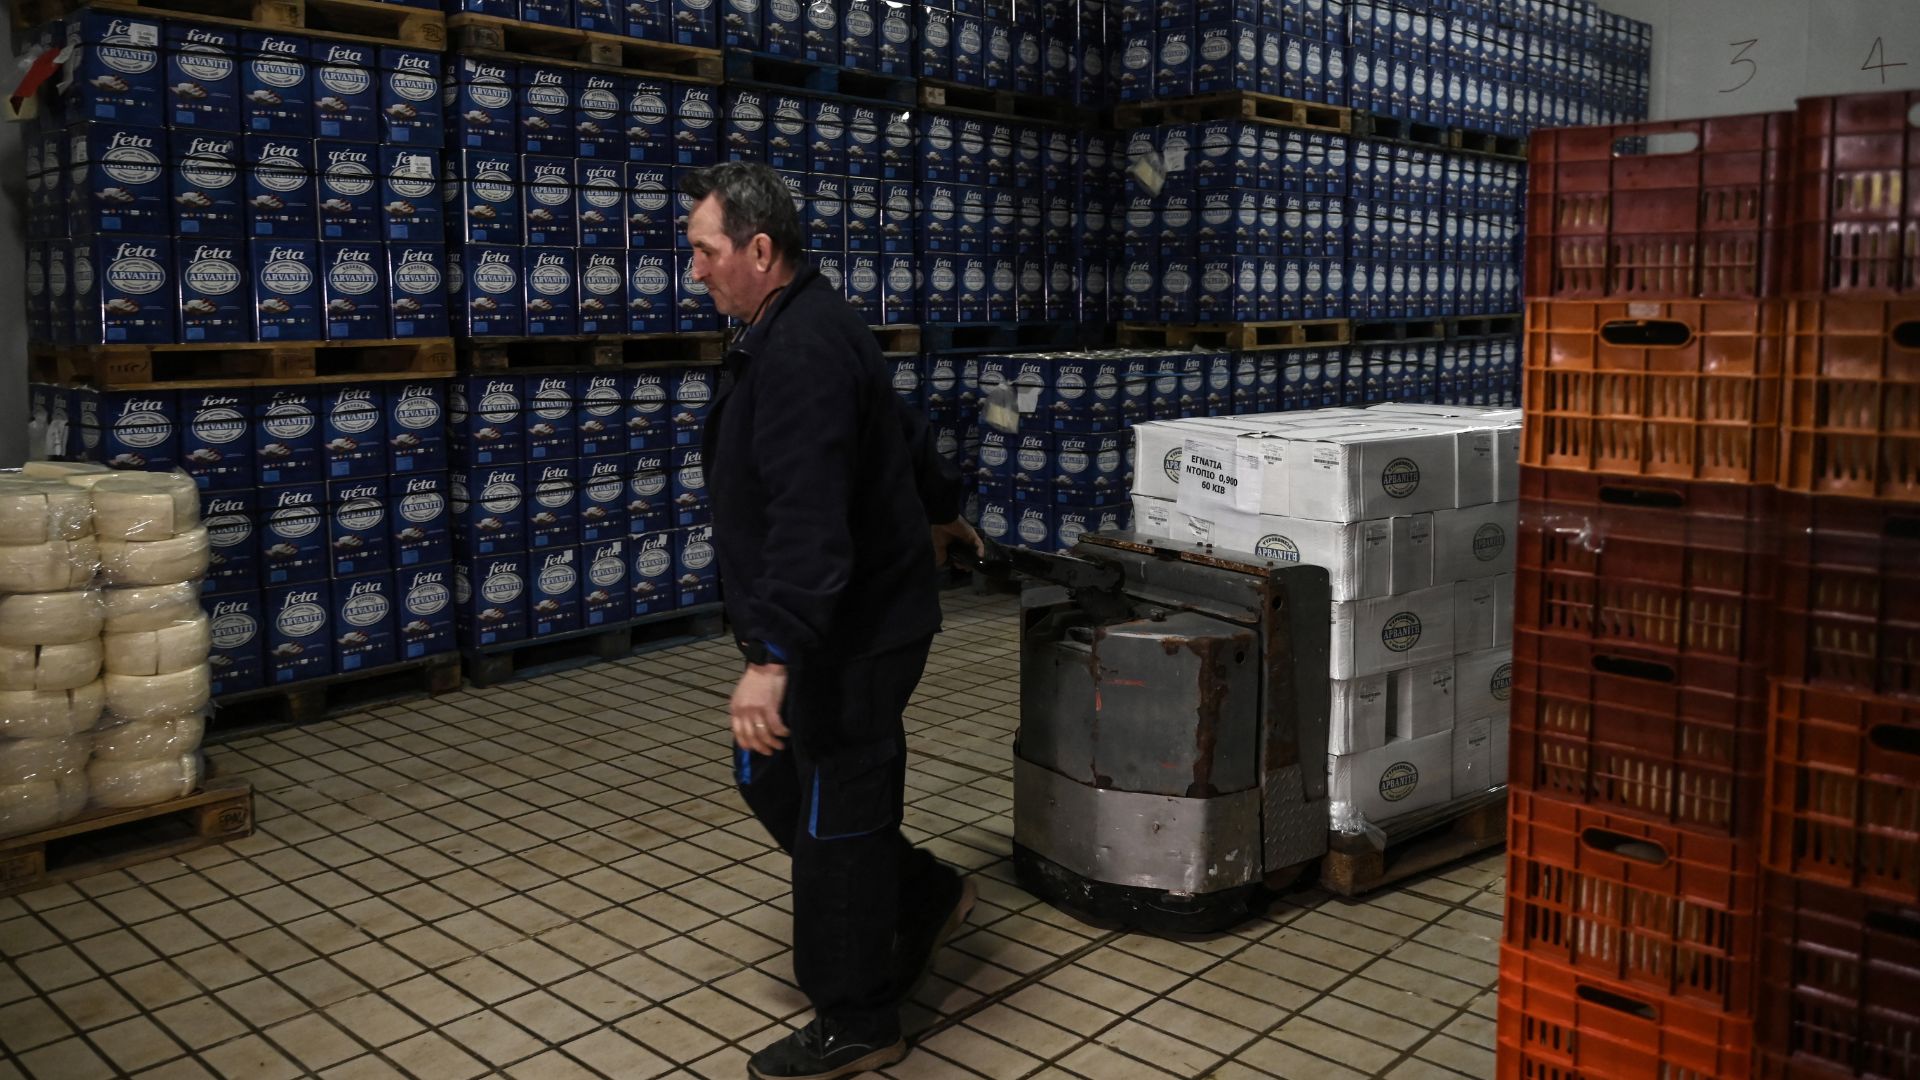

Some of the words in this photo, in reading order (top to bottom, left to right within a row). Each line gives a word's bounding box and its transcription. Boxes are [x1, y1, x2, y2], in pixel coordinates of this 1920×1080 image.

[885, 7, 906, 20] feta
[929, 12, 947, 24] feta
[963, 20, 980, 31] feta
[185, 28, 225, 46] feta
[1166, 33, 1186, 44] feta
[1241, 27, 1254, 39] feta
[261, 37, 297, 54] feta
[1127, 38, 1147, 49] feta
[102, 47, 153, 62] ARVANITI
[327, 45, 363, 62] feta
[180, 56, 229, 69] ARVANITI
[394, 54, 431, 71] feta
[1718, 38, 1758, 92] 3
[1861, 36, 1907, 84] 4
[256, 63, 301, 76] ARVANITI
[473, 63, 506, 79] feta
[320, 72, 366, 84] ARVANITI
[531, 70, 563, 85] feta
[585, 76, 613, 91] feta
[394, 79, 434, 91] ARVANITI
[472, 86, 508, 98] ARVANITI
[530, 92, 566, 104] ARVANITI
[683, 88, 709, 102] feta
[583, 99, 617, 110] ARVANITI
[735, 92, 761, 106] feta
[776, 97, 800, 109] feta
[633, 104, 664, 115] ARVANITI
[681, 109, 711, 119] ARVANITI
[819, 102, 840, 115] feta
[854, 107, 874, 119] feta
[932, 116, 949, 128] feta
[964, 120, 981, 131] feta
[994, 125, 1010, 135] feta
[1167, 128, 1186, 139] feta
[1205, 126, 1227, 136] φέτα
[1242, 126, 1256, 136] feta
[106, 131, 153, 149] feta
[1131, 131, 1150, 142] feta
[185, 137, 228, 156] feta
[259, 142, 299, 159] feta
[328, 148, 368, 165] φέτα
[476, 158, 510, 173] φέτα
[534, 163, 565, 177] φέτα
[586, 166, 616, 180] φέτα
[635, 169, 664, 182] φέτα
[817, 180, 838, 192] feta
[891, 186, 908, 198] feta
[934, 187, 951, 198] feta
[965, 190, 982, 201] feta
[996, 192, 1012, 203] feta
[1242, 193, 1255, 203] feta
[1132, 197, 1151, 207] feta
[1168, 196, 1187, 207] feta
[112, 242, 157, 262] feta
[189, 245, 233, 264] feta
[265, 246, 305, 264] feta
[332, 247, 371, 265] feta
[398, 248, 434, 266] feta
[478, 250, 510, 266] feta
[534, 252, 565, 268] feta
[587, 253, 616, 269] feta
[636, 254, 663, 270] feta
[820, 256, 838, 268] feta
[854, 257, 874, 269] feta
[890, 257, 909, 270] feta
[934, 258, 951, 269] feta
[966, 259, 983, 269] feta
[996, 259, 1011, 270] feta
[1242, 260, 1255, 270] feta
[1130, 262, 1149, 272] feta
[1168, 263, 1187, 273] feta
[111, 271, 161, 280] ARVANITI
[189, 272, 237, 281] ARVANITI
[265, 273, 309, 282] ARVANITI
[332, 274, 374, 282] ARVANITI
[398, 274, 437, 282] ARVANITI
[476, 273, 513, 283] ARVANITI
[533, 275, 568, 284] ARVANITI
[586, 276, 619, 285] ARVANITI
[635, 276, 666, 284] ARVANITI
[897, 361, 915, 373] feta
[936, 360, 953, 369] feta
[983, 361, 1003, 372] feta
[1019, 362, 1041, 374] feta
[1129, 361, 1144, 372] feta
[1159, 360, 1174, 370] feta
[1185, 359, 1200, 370] feta
[1213, 357, 1227, 368] feta
[1059, 364, 1083, 375] φέτα
[1099, 364, 1115, 374] feta
[588, 376, 616, 391] feta
[635, 373, 661, 388] feta
[680, 371, 706, 386] feta
[484, 381, 514, 397] feta
[537, 378, 566, 394] feta
[334, 387, 372, 405] feta
[398, 385, 433, 402] feta
[680, 390, 709, 399] ARVANITI
[118, 397, 164, 417] feta
[482, 403, 517, 413] ARVANITI
[534, 400, 571, 409] ARVANITI
[334, 411, 376, 422] ARVANITI
[397, 409, 437, 419] ARVANITI
[196, 421, 243, 431] ARVANITI
[266, 417, 311, 427] ARVANITI
[984, 432, 1004, 444] feta
[1022, 436, 1042, 448] feta
[1062, 438, 1085, 450] φέτα
[1101, 438, 1116, 449] feta
[636, 457, 661, 470] feta
[1191, 454, 1222, 471] ΕΓΝΑΤΙΑ
[542, 466, 569, 480] feta
[592, 462, 618, 476] feta
[1186, 465, 1215, 480] ΝΤΟΠΙΟ
[485, 471, 516, 487] feta
[1383, 471, 1419, 485] ΑΡΒΑΝΙΤΗ
[407, 478, 437, 493] feta
[1201, 481, 1211, 490] 60
[1212, 484, 1226, 495] ΚΙΒ
[340, 485, 378, 501] φέτα
[278, 491, 312, 508] feta
[207, 499, 245, 515] feta
[403, 501, 441, 512] ARVANITI
[984, 502, 1005, 514] feta
[1022, 507, 1043, 519] feta
[1102, 512, 1116, 522] feta
[1257, 548, 1299, 562] ΑΡΒΑΝΙΤΗ
[486, 562, 518, 578] feta
[409, 571, 443, 591] feta
[541, 574, 575, 587] ARVANITI
[346, 581, 382, 599] feta
[485, 582, 521, 594] ARVANITI
[281, 591, 319, 610] feta
[409, 593, 445, 605] ARVANITI
[212, 601, 249, 618] feta
[346, 603, 386, 615] ARVANITI
[280, 613, 321, 626] ARVANITI
[1382, 625, 1421, 641] ΑΡΒΑΝΙΤΗ
[1381, 773, 1418, 790] ΑΡΒΑΝΙΤΗ
